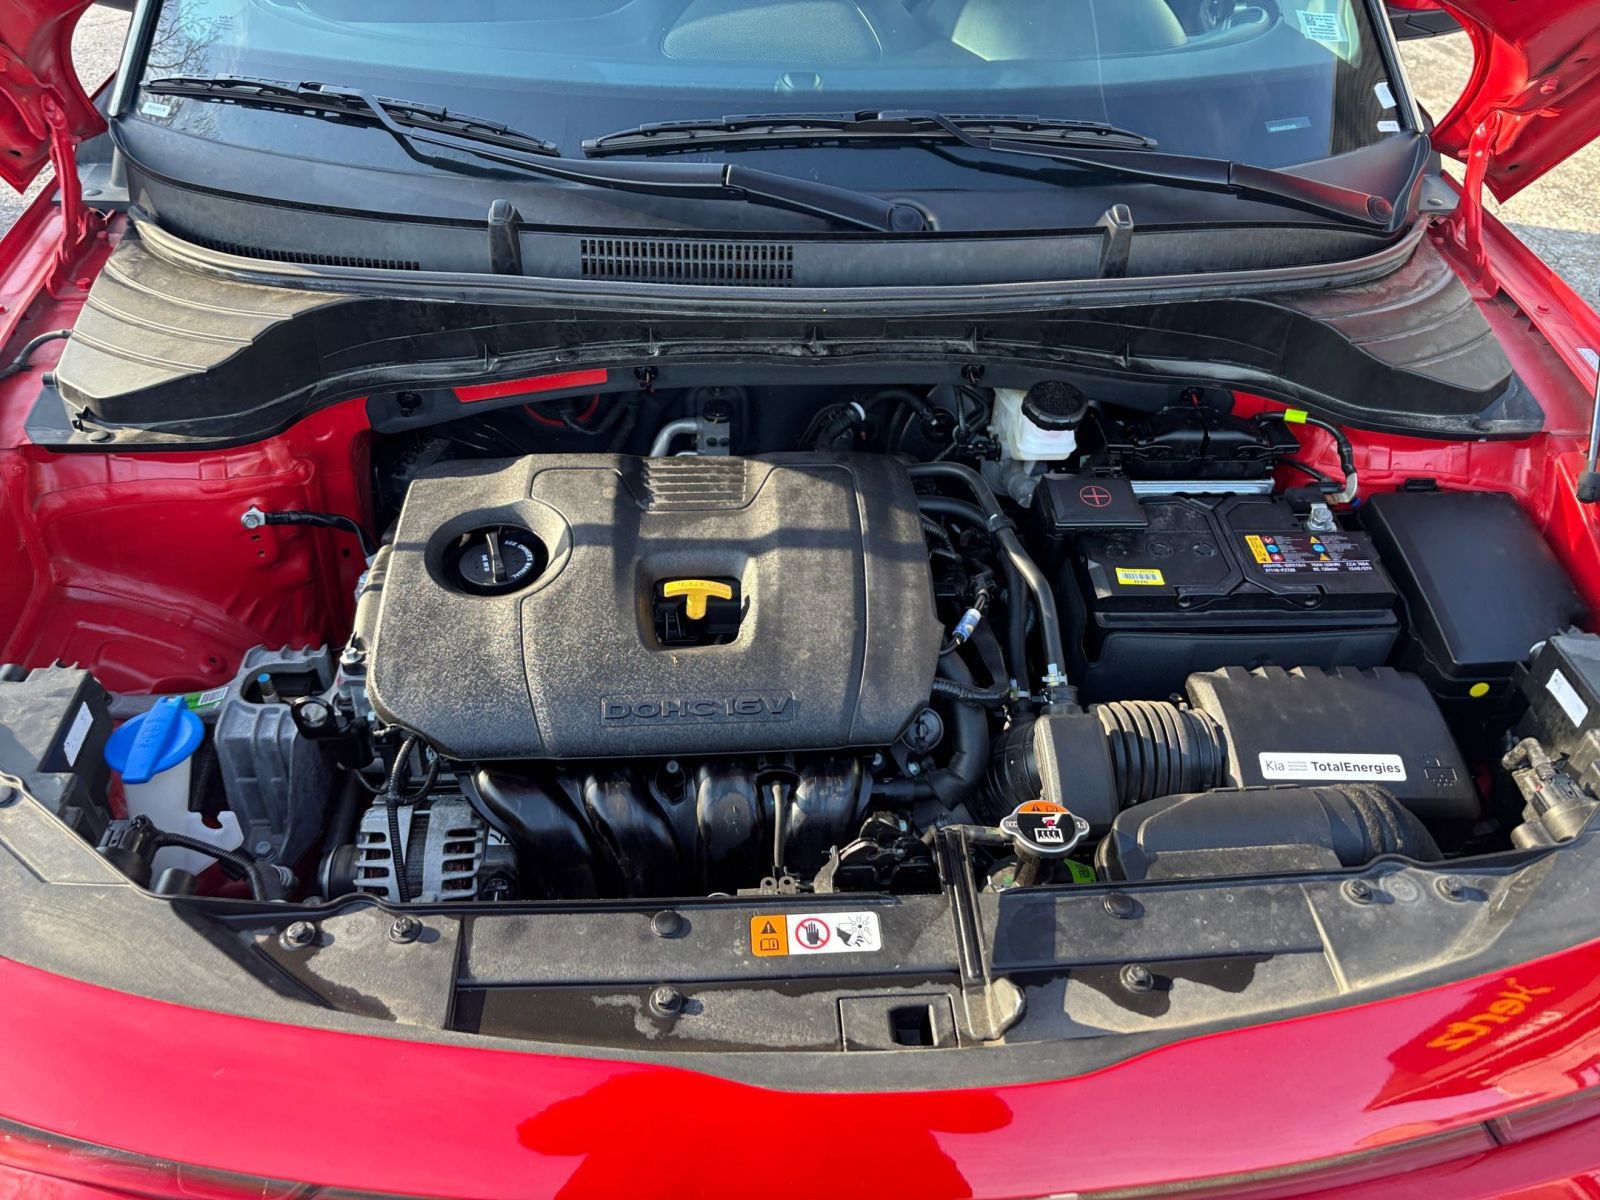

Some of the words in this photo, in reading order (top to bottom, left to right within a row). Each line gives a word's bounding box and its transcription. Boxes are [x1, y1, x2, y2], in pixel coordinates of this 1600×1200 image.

[601, 699, 715, 719] DOHC
[725, 696, 791, 716] 16V
[1265, 760, 1285, 771] Kia
[1310, 760, 1401, 774] TotalEnergies
